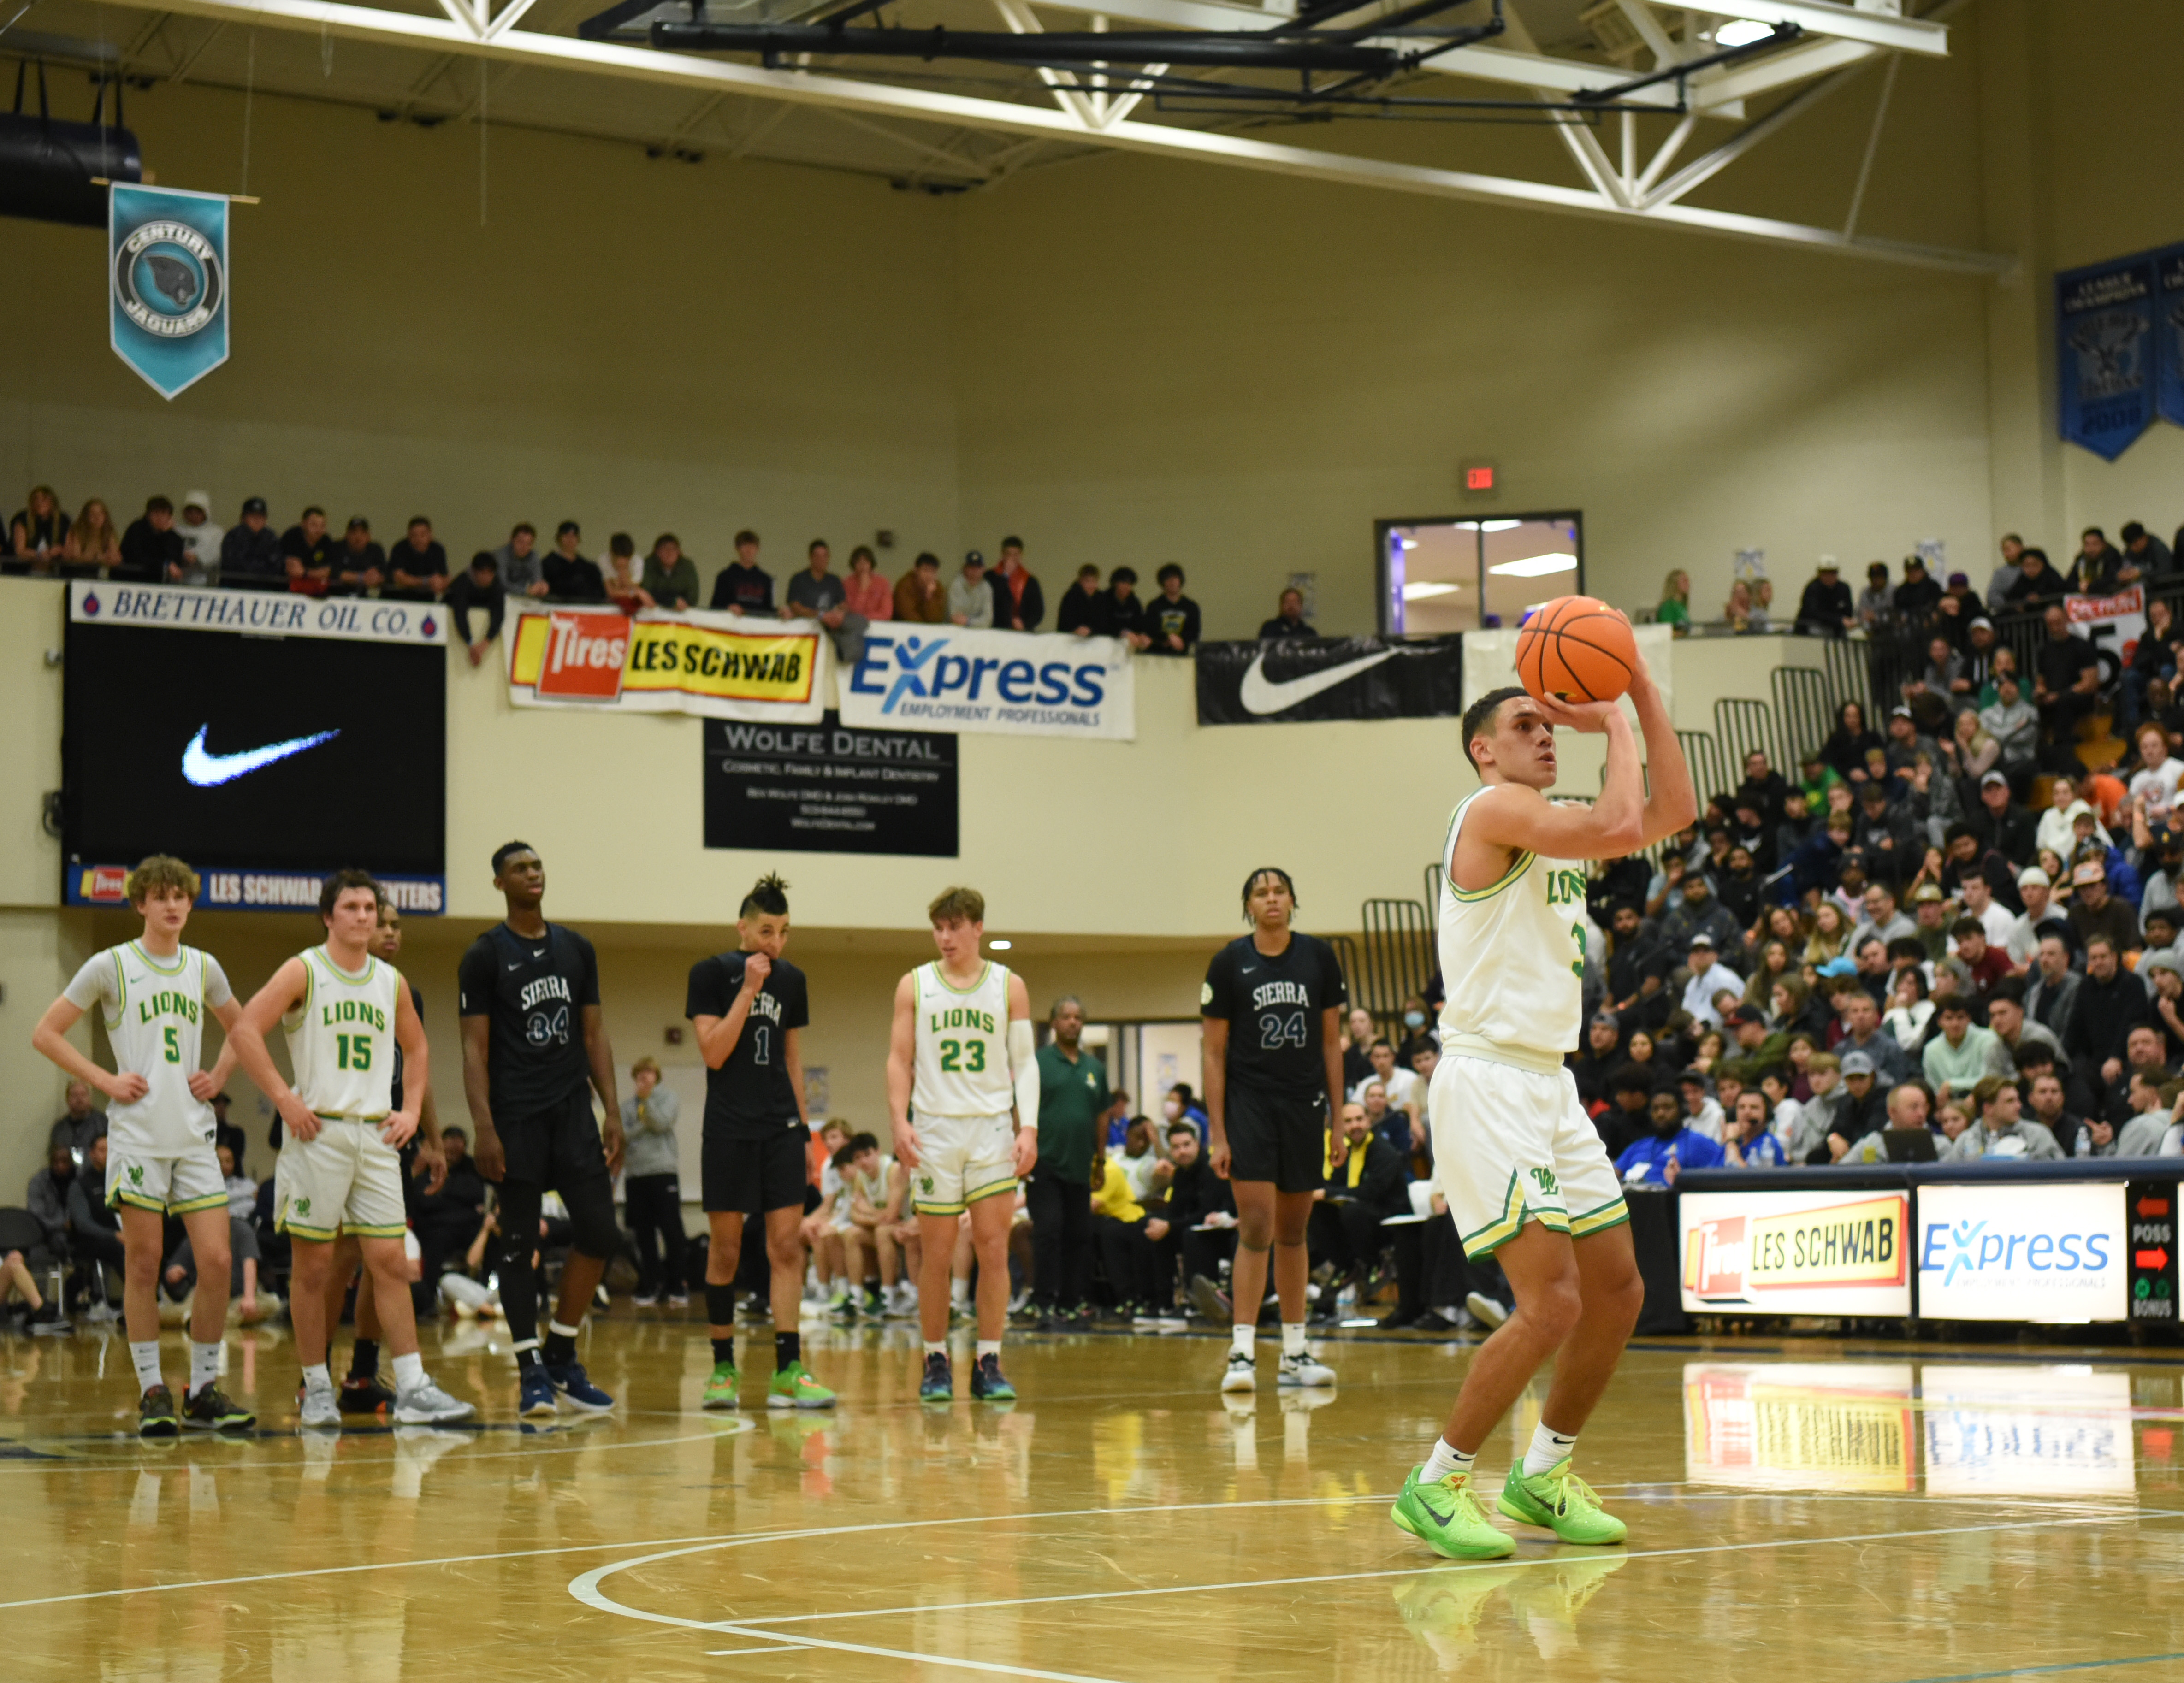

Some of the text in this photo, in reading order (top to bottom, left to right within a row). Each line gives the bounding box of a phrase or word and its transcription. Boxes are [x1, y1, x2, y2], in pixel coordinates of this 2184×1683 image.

[126, 224, 213, 260] CENTURY
[126, 301, 209, 335] JAGUARS
[113, 589, 410, 635] BRETTHAUER OIL CO.
[550, 619, 626, 674] Tires
[631, 639, 801, 683] LES SCHWAB
[900, 702, 1100, 726] EMPLOYMENT PROFESSIONALS
[724, 725, 940, 760] WOLFE DENTAL
[209, 873, 242, 904] LES
[139, 990, 198, 1026] LIONS
[521, 975, 572, 1011] SIERRA
[750, 992, 782, 1028] ERRA
[1252, 981, 1310, 1011] SIERRA
[323, 999, 385, 1033] LIONS
[526, 1005, 569, 1047] 34
[930, 1007, 995, 1035] LIONS
[1259, 1011, 1307, 1050] 24
[163, 1024, 181, 1064] 5
[336, 1032, 372, 1072] 15
[754, 1025, 769, 1065] 1
[940, 1038, 986, 1072] 23
[1753, 1217, 1893, 1271] LES SCHWAB
[2132, 1223, 2171, 1244] POSS
